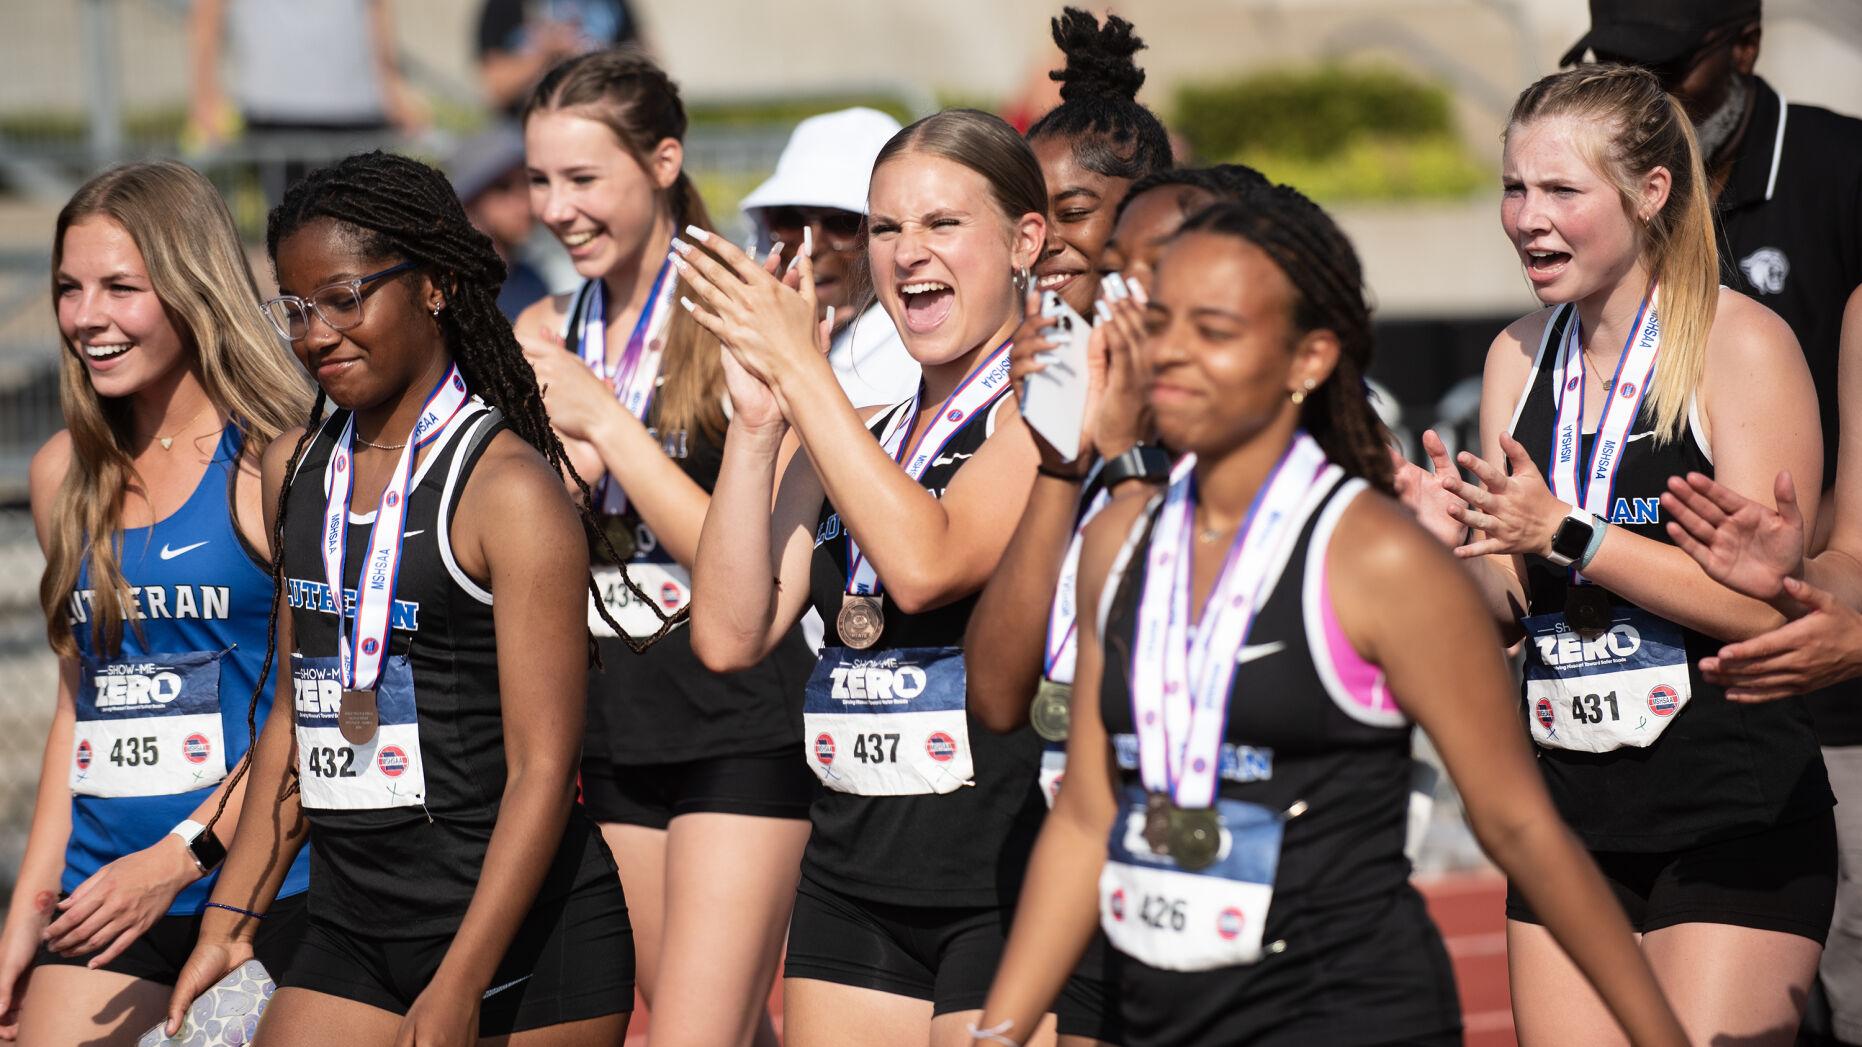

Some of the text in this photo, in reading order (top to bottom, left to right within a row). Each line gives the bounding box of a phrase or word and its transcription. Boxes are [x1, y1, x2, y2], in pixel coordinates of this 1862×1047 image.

[1560, 424, 1573, 463] MSHSAA
[1595, 440, 1616, 479] MSHSAA
[1611, 498, 1660, 524] AN
[328, 513, 340, 555] MSHSAA
[371, 548, 391, 590] MSHSAA
[70, 584, 230, 626] UTERAN
[284, 577, 420, 631] UTHEN
[1534, 624, 1640, 666] ZERO
[107, 663, 157, 676] SHOW-ME
[300, 668, 341, 680] SHOW-M
[829, 665, 927, 699] ZERO
[94, 671, 182, 708] ZERO
[294, 678, 342, 713] ZER
[1572, 690, 1620, 724] 431
[110, 736, 160, 767] 435
[309, 747, 357, 778] 432
[853, 733, 900, 764] 437
